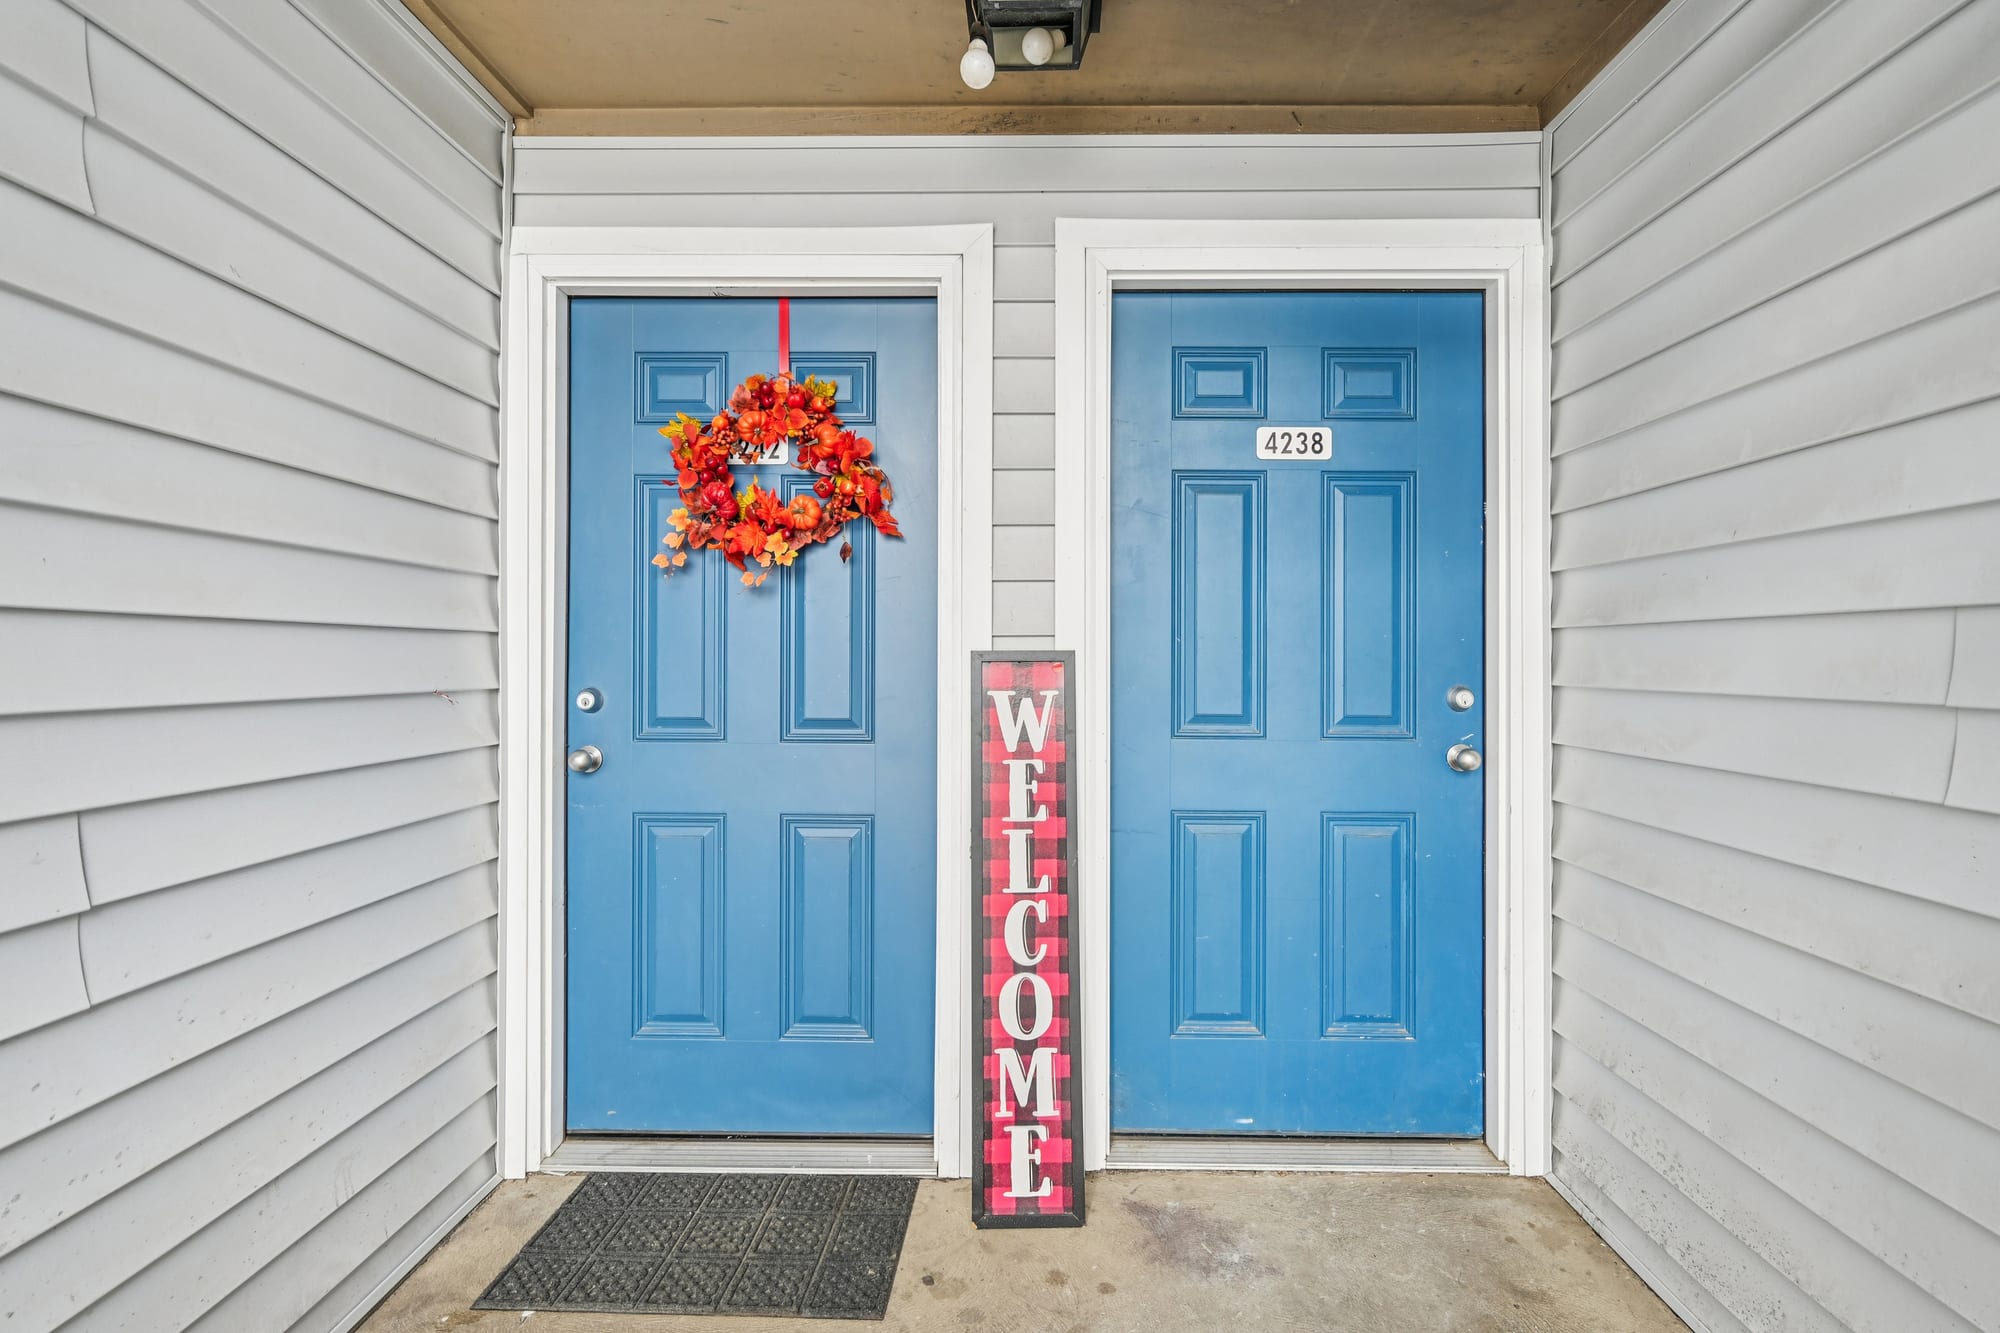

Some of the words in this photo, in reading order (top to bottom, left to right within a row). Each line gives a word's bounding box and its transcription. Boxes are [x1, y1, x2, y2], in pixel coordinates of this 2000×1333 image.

[729, 437, 780, 459] 242
[1264, 431, 1324, 454] 4238
[987, 689, 1059, 1199] WELCOME
